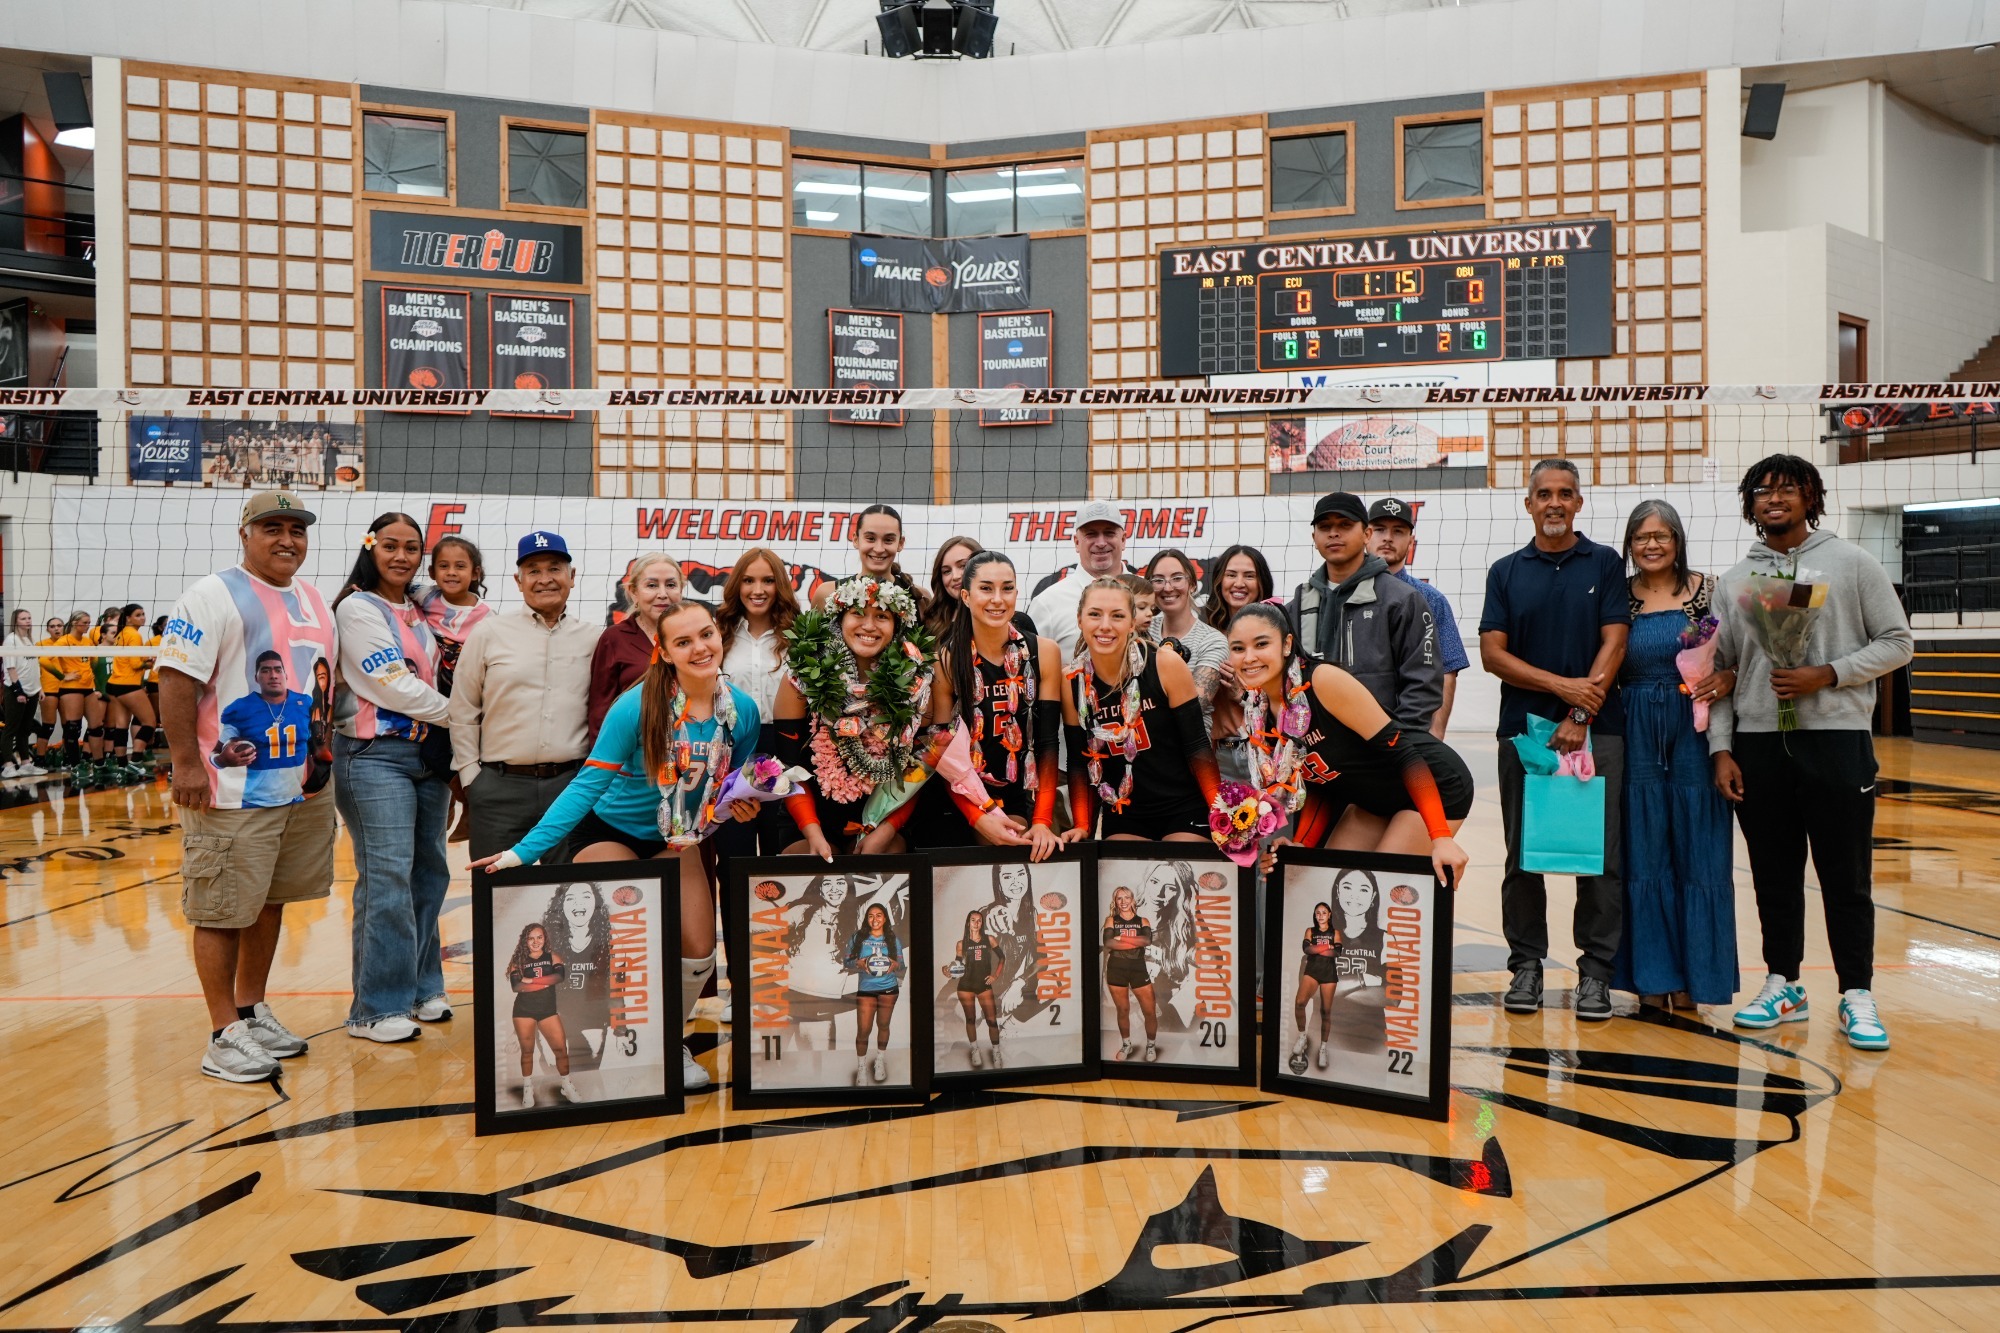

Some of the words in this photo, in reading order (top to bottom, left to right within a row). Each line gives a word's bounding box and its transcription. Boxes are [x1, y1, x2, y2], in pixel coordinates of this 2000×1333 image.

[1173, 250, 1246, 276] EAST
[1257, 240, 1396, 270] CENTRAL
[1408, 225, 1597, 260] UNIVERSITY
[1531, 257, 1538, 267] F
[1545, 255, 1564, 266] PTS
[874, 264, 923, 281] MAKE
[951, 255, 1020, 290] YOURS
[1223, 276, 1230, 287] F
[1236, 275, 1254, 286] PTS
[1285, 277, 1302, 288] ECU
[1469, 279, 1483, 303] 0
[405, 292, 446, 307] MEN'S
[511, 299, 550, 313] MEN'S
[1297, 290, 1311, 313] 0
[1337, 300, 1354, 308] POSS
[1402, 296, 1419, 304] POSS
[388, 304, 463, 320] BASKETBALL
[495, 311, 567, 326] BASKETBALL
[1355, 307, 1385, 317] PERIOD
[1395, 302, 1401, 320] 1
[1441, 307, 1469, 318] BONUS
[848, 314, 883, 327] MEN'S
[998, 315, 1032, 327] MEN'S
[1290, 316, 1317, 326] BONUS
[1436, 323, 1452, 332] TOL
[1460, 321, 1486, 331] FOULS
[834, 325, 897, 340] BASKETBALL
[984, 326, 1046, 340] BASKETBALL
[1272, 331, 1298, 341] FOULS
[1305, 330, 1321, 339] TOL
[1334, 328, 1364, 338] PLAYER
[1397, 324, 1423, 334] FOULS
[390, 338, 463, 353] CHAMPIONS
[1438, 332, 1451, 351] 2
[1473, 330, 1487, 350] 0
[496, 344, 566, 358] CHAMPIONS
[1285, 340, 1298, 359] 0
[1307, 339, 1320, 358] 2
[833, 356, 899, 370] TOURNAMENT
[983, 357, 1048, 371] TOURNAMENT
[836, 368, 895, 381] CHAMPIONS
[187, 390, 244, 406] EAST
[247, 390, 349, 406] CENTRAL
[352, 390, 491, 406] UNIVERSITY
[607, 390, 664, 406] EAST
[666, 390, 767, 406] CENTRAL
[769, 389, 907, 405] UNIVERSITY
[1020, 388, 1078, 404] EAST
[1079, 388, 1178, 404] CENTRAL
[1180, 388, 1314, 404] UNIVERSITY
[1425, 387, 1480, 403] EAST
[1482, 387, 1578, 403] CENTRAL
[1580, 385, 1710, 402] UNIVERSITY
[1819, 384, 1872, 399] EAST
[1874, 383, 1966, 399] CENTRAL
[1970, 383, 2000, 398] UN
[850, 409, 882, 420] 2017
[1000, 408, 1031, 421] 2017
[156, 438, 180, 446] MAKE
[1364, 445, 1392, 455] Court
[136, 440, 190, 463] YOURS
[1338, 459, 1354, 467] Kerr
[1356, 458, 1391, 466] Activities
[1393, 457, 1418, 465] Center
[276, 494, 292, 510] LA
[636, 508, 824, 541] WELCOME
[1008, 511, 1077, 542] THE
[534, 532, 549, 548] LA
[1422, 611, 1434, 665] CINCH
[265, 722, 297, 760] 11
[682, 761, 707, 793] 3
[975, 950, 982, 960] 2
[1037, 911, 1071, 1000] RAMOS
[1195, 895, 1232, 1018] GOODWIN
[1345, 948, 1377, 958] CENTRAL
[609, 907, 648, 1030] TIJERINA
[752, 905, 791, 1028] KAWAA
[570, 973, 584, 989] 3
[1384, 906, 1421, 1051] MALDONADO
[1049, 1004, 1061, 1026] 2
[1200, 1021, 1227, 1048] 20
[624, 1029, 638, 1057] 3
[761, 1035, 782, 1061] 11
[1388, 1049, 1414, 1076] 22
